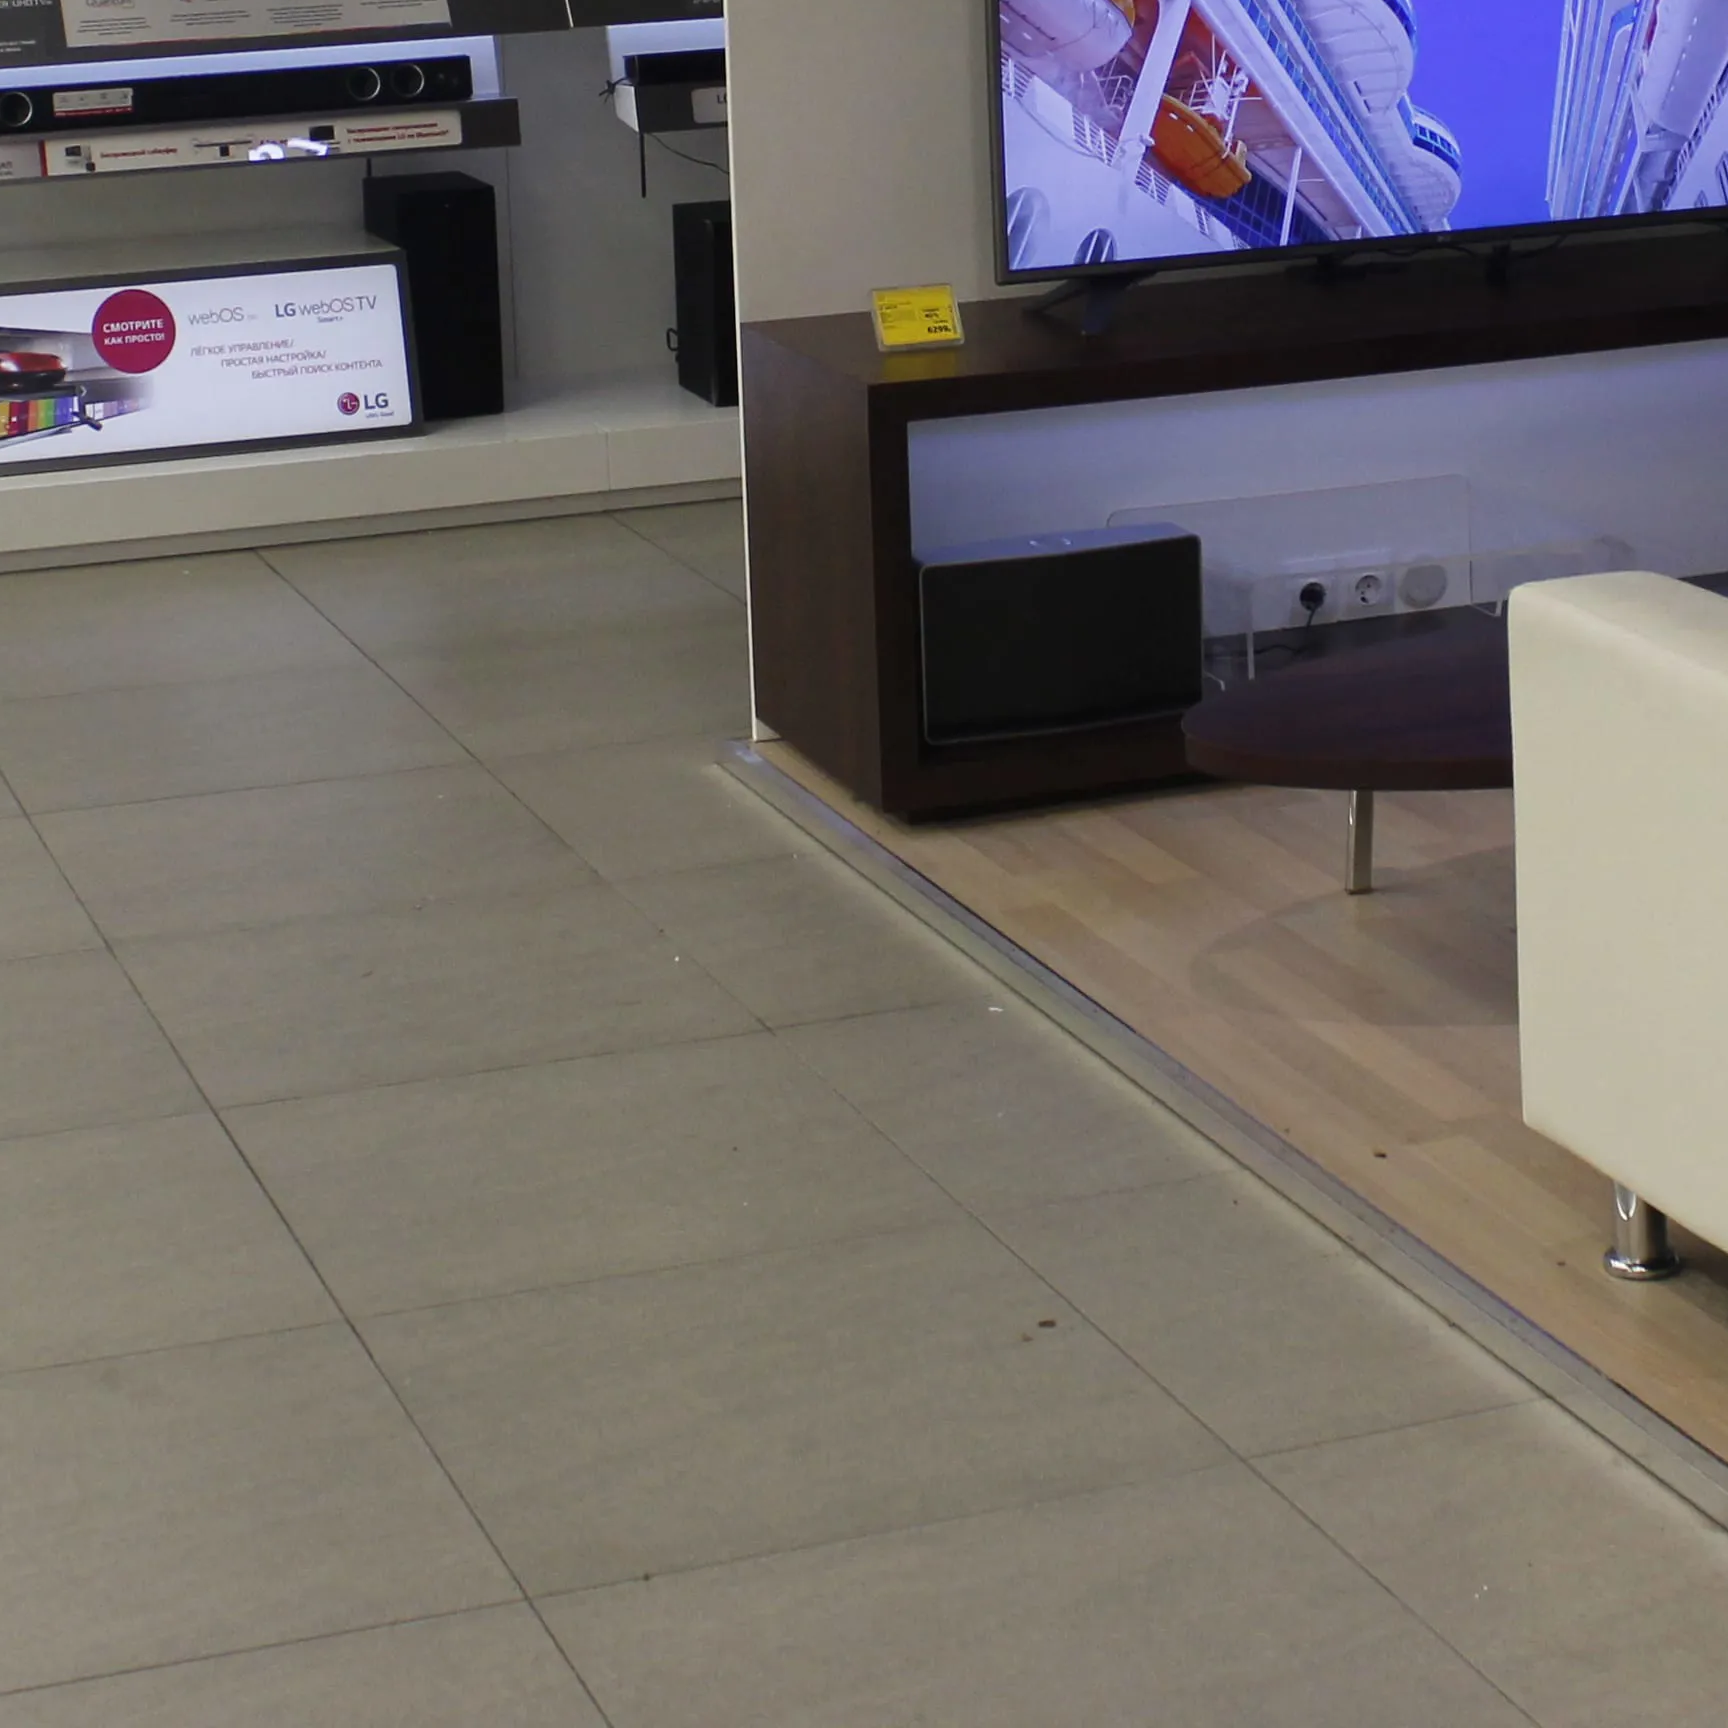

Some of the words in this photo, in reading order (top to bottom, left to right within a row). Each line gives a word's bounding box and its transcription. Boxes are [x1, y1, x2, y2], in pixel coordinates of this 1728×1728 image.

[187, 306, 245, 326] webOS
[275, 302, 297, 319] LG
[298, 297, 354, 317] webOS
[355, 295, 378, 312] TV
[102, 318, 165, 334] СМОТРИТЕ
[103, 334, 123, 346] КАК
[125, 332, 165, 345] ПРОСТО!
[220, 355, 265, 368] ПРОСТАЯ
[299, 363, 334, 376] ПОИСК
[334, 358, 383, 373] КОНТЕНТА
[363, 392, 390, 411] LG
